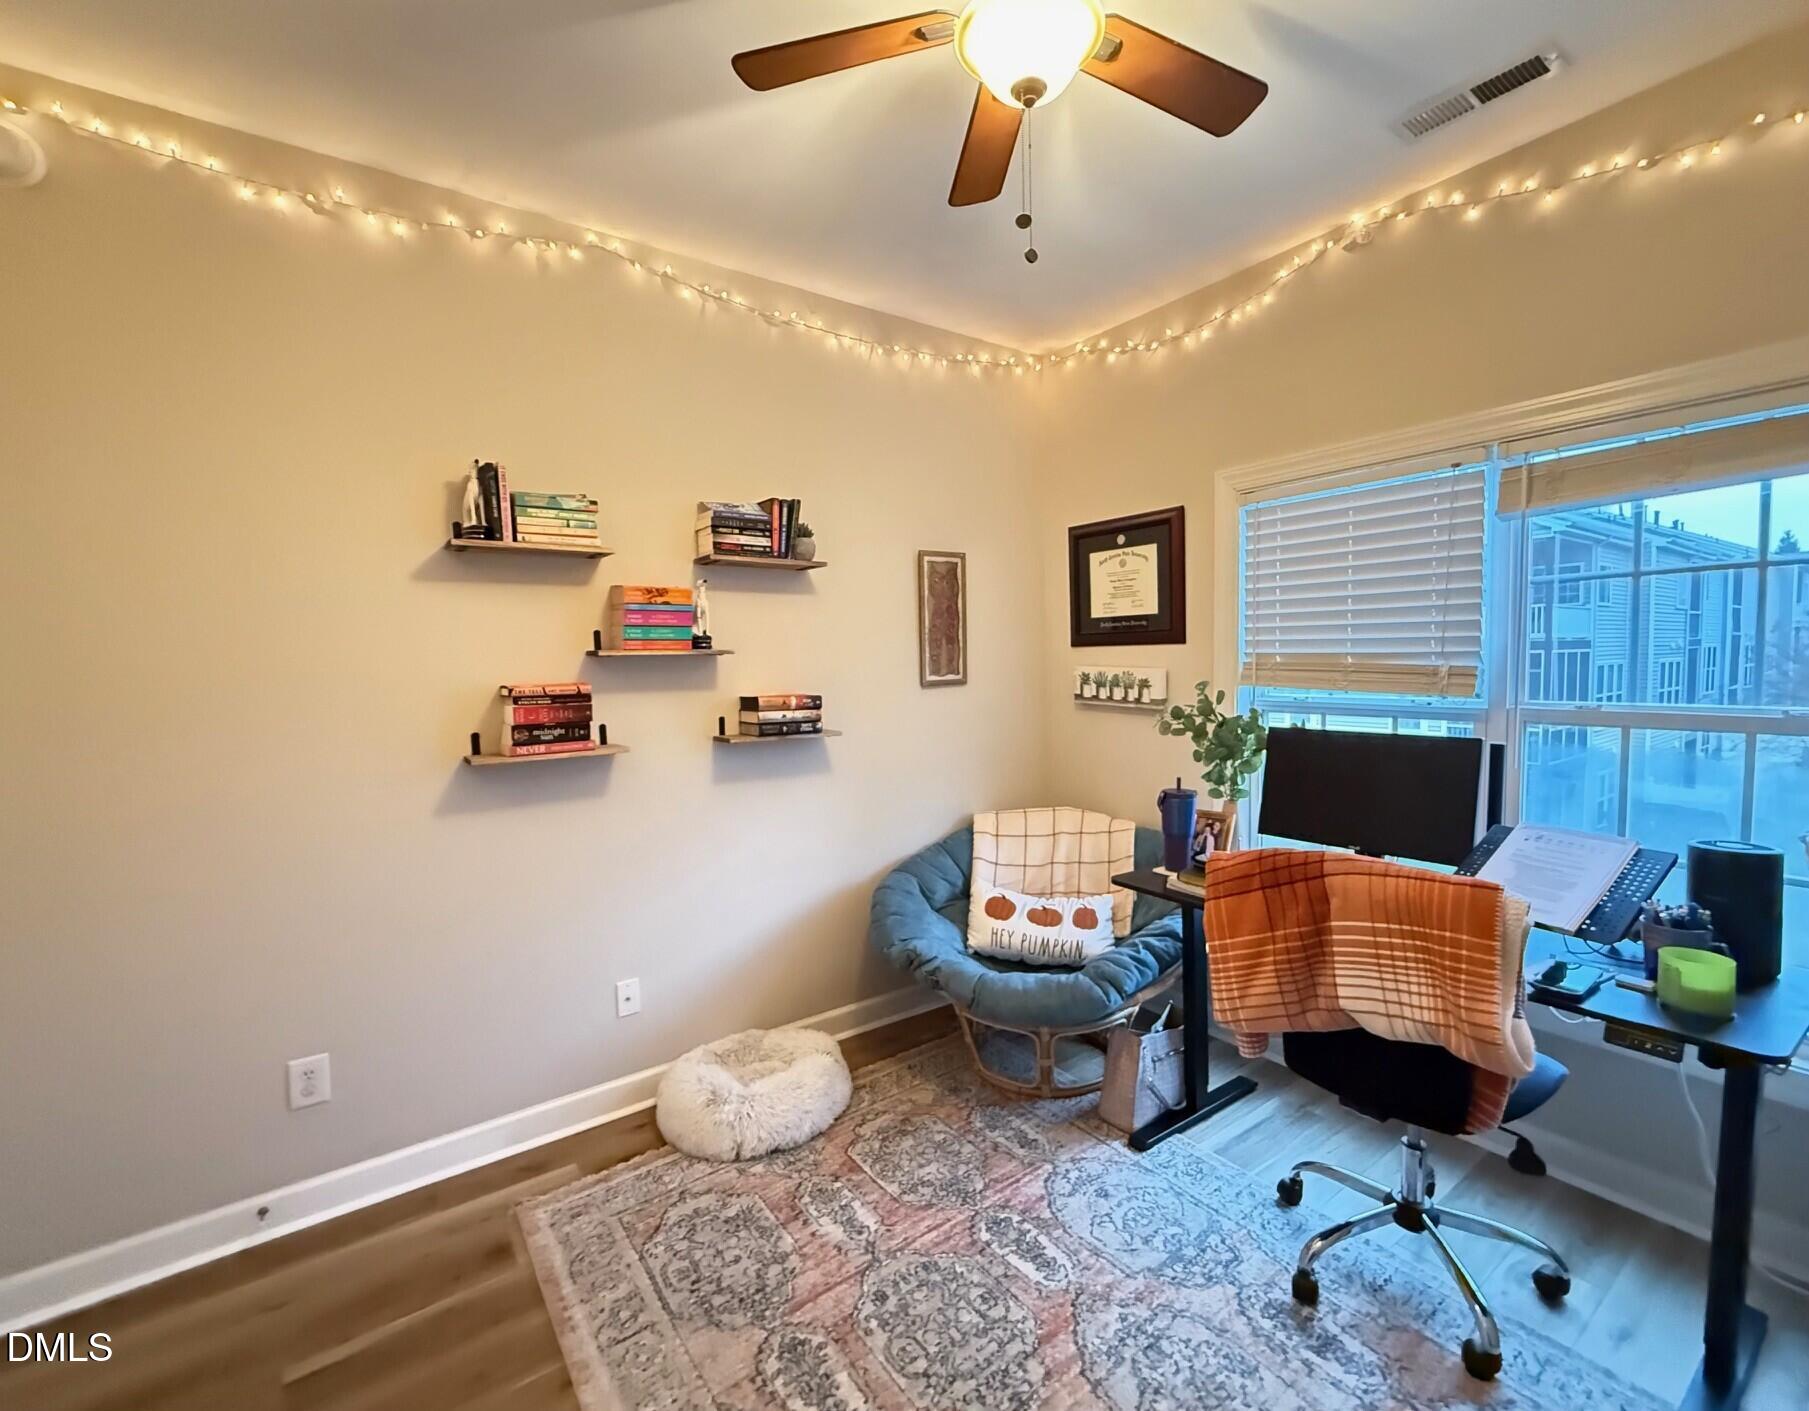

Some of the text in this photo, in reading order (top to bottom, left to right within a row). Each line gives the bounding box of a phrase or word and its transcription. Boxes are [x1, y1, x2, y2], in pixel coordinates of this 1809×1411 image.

[533, 728, 565, 737] midnight
[516, 745, 546, 754] NEVER
[991, 927, 1084, 959] HEY PUMPKIN
